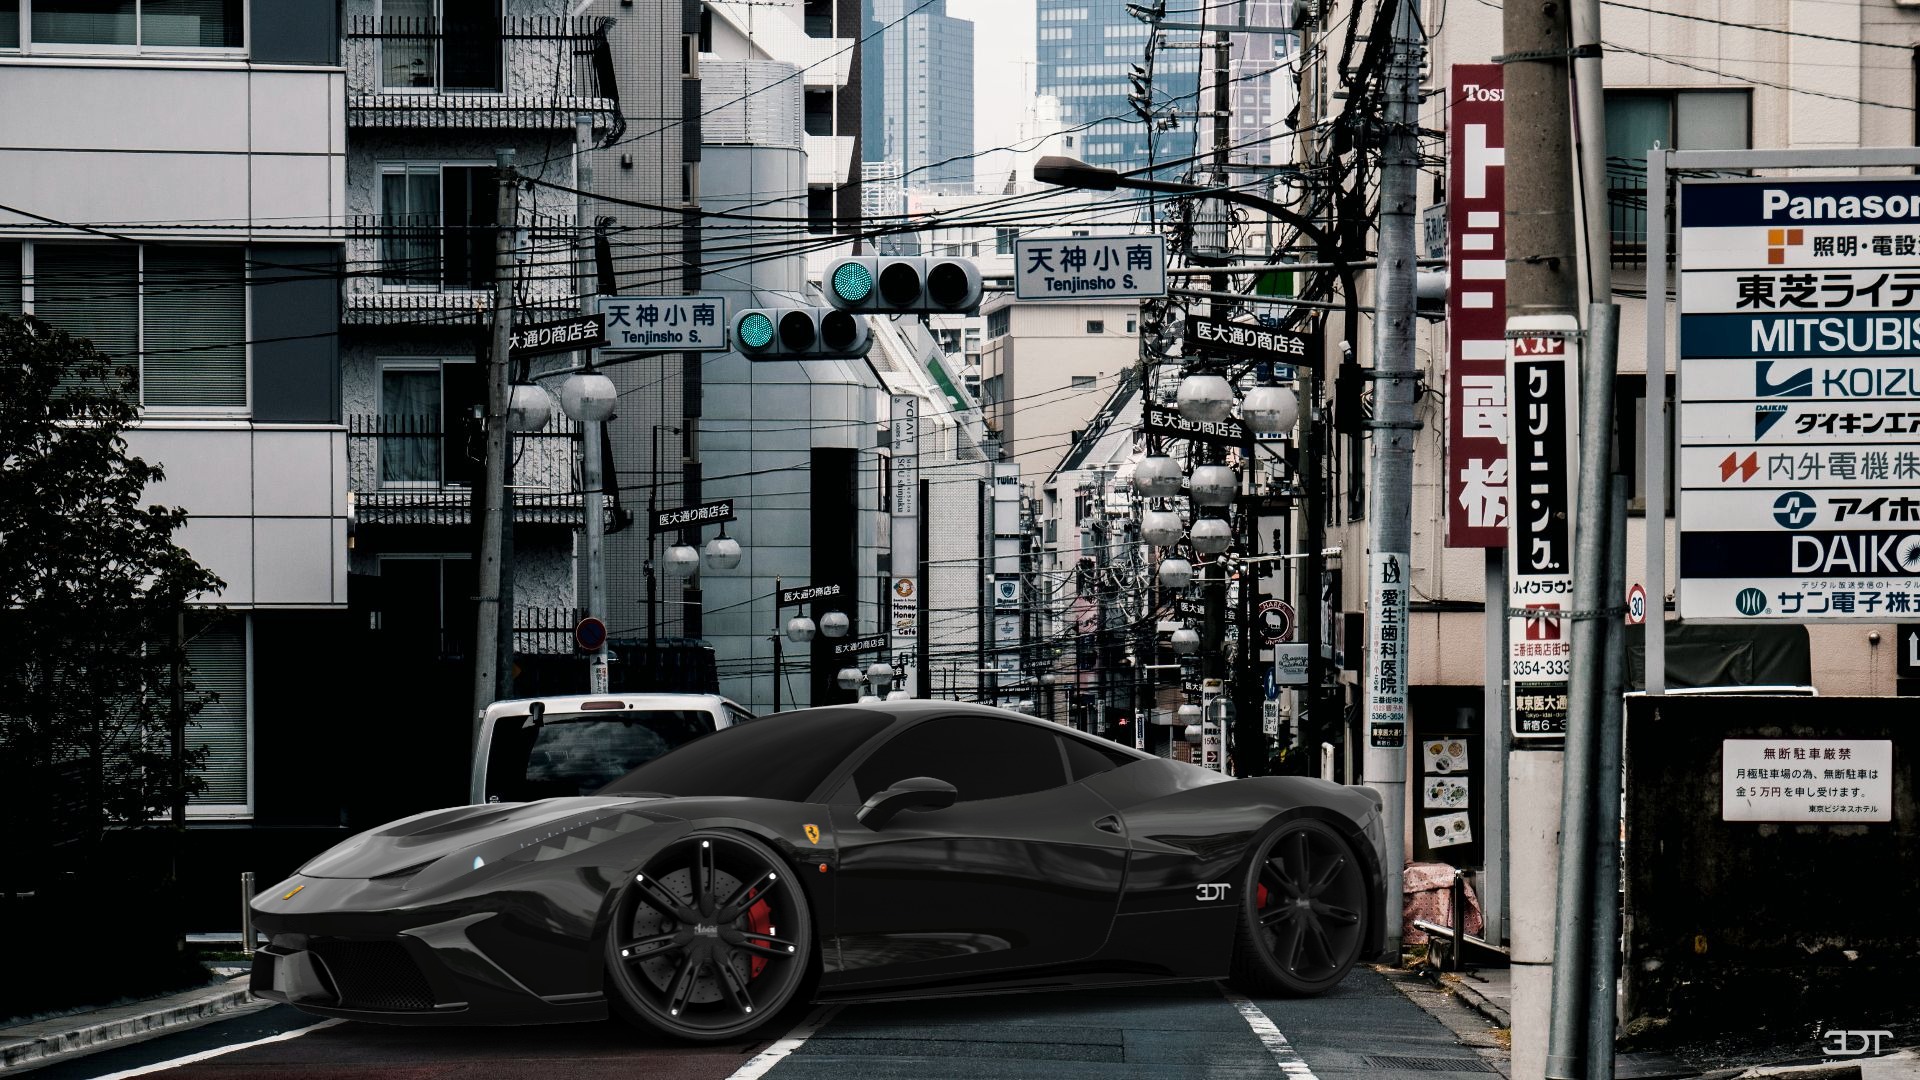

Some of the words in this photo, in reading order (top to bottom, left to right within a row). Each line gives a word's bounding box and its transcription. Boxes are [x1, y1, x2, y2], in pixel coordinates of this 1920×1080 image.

[1813, 235, 1920, 257] 照明・電設
[1027, 243, 1153, 273] 天神小南
[1044, 276, 1115, 294] Tenjinsho
[1123, 274, 1138, 290] S.
[607, 303, 716, 328] 天神小南
[621, 329, 683, 344] Tenjinsho
[688, 329, 702, 343] S.
[1197, 321, 1305, 356] 医大通り商店会
[906, 399, 914, 443] LIVIDA
[1528, 365, 1560, 571] クリーニング
[659, 504, 729, 526] 医大通り商店会
[784, 584, 840, 602] 医大通り商店会
[893, 603, 916, 611] Honey
[893, 611, 916, 619] Honey
[1631, 597, 1643, 616] 30
[1381, 589, 1398, 694] 愛生歯科医院
[1763, 747, 1852, 760] 無断駐車厳禁
[1736, 768, 1879, 780] 月極駐車場の為、無断駐車は
[1808, 804, 1879, 813] 東京ビジネスホテル
